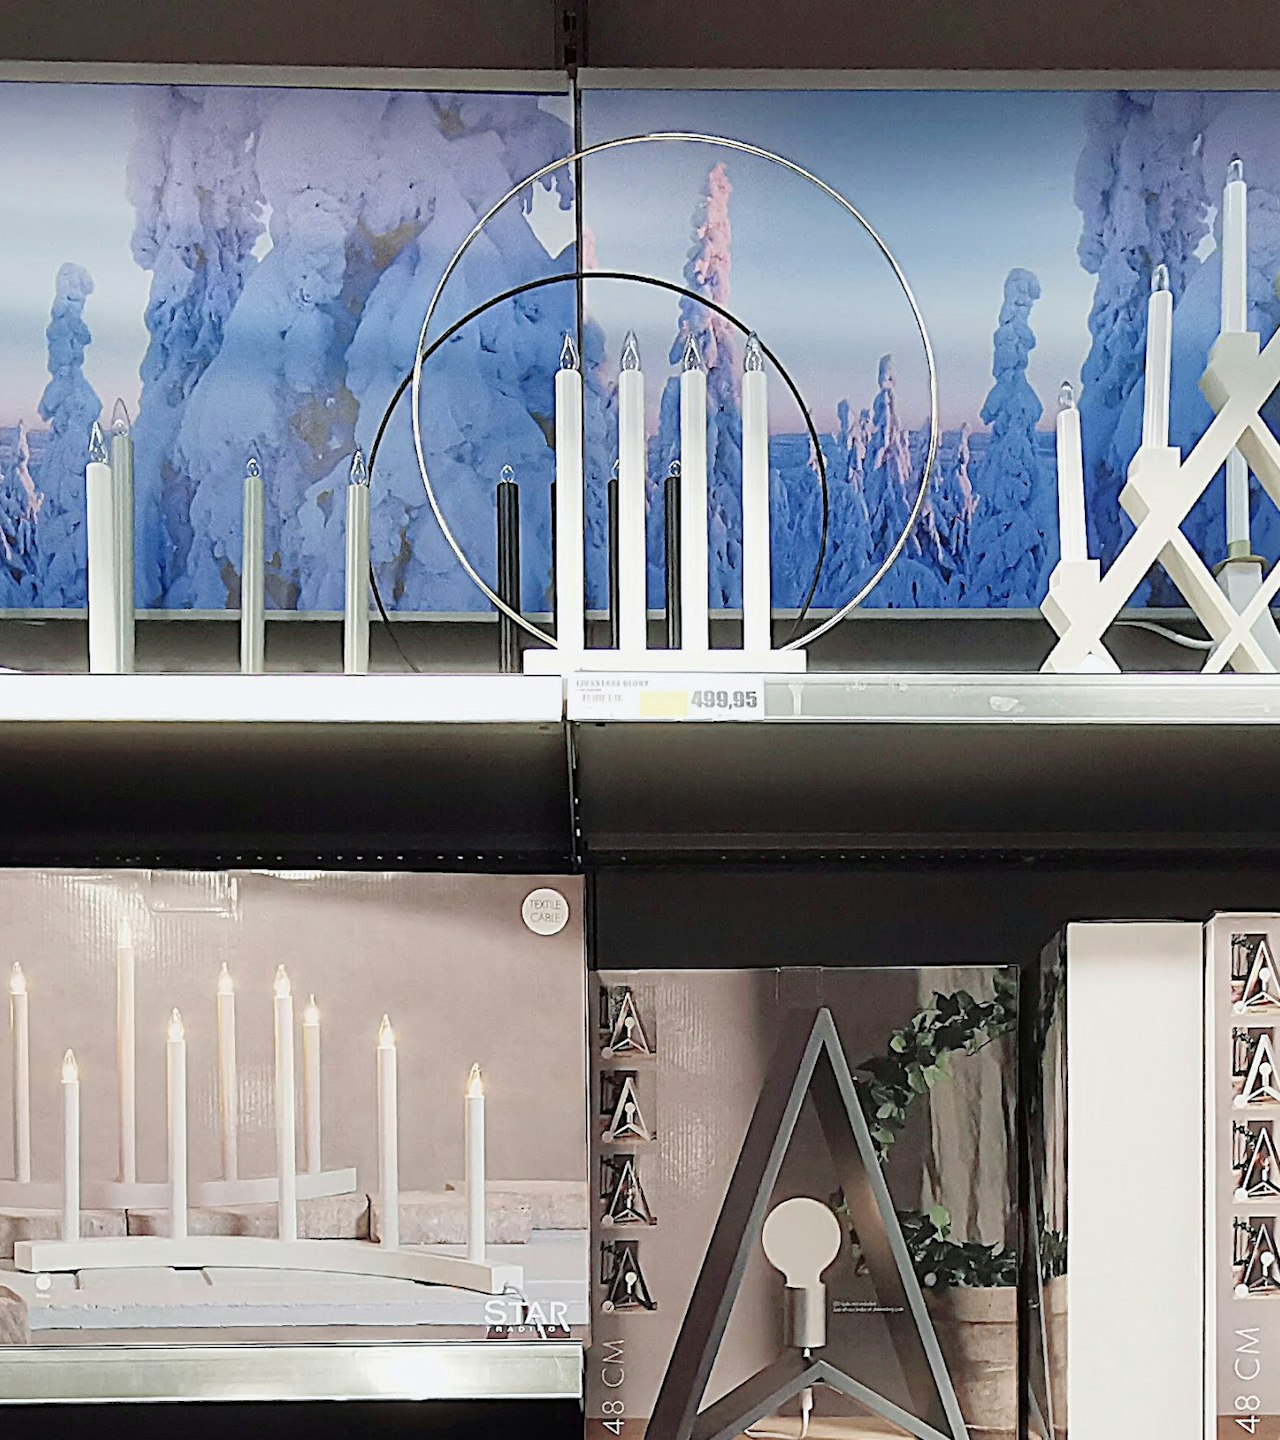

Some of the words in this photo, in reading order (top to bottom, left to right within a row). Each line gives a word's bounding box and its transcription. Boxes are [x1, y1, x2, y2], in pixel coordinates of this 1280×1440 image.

[691, 690, 758, 709] 499,95
[529, 900, 561, 909] TEXTILE
[530, 913, 561, 922] CABLE
[484, 1300, 570, 1332] STAR
[601, 1338, 626, 1391] CM
[1234, 1326, 1261, 1381] CM
[601, 1398, 625, 1435] 48
[1235, 1394, 1261, 1435] 48
